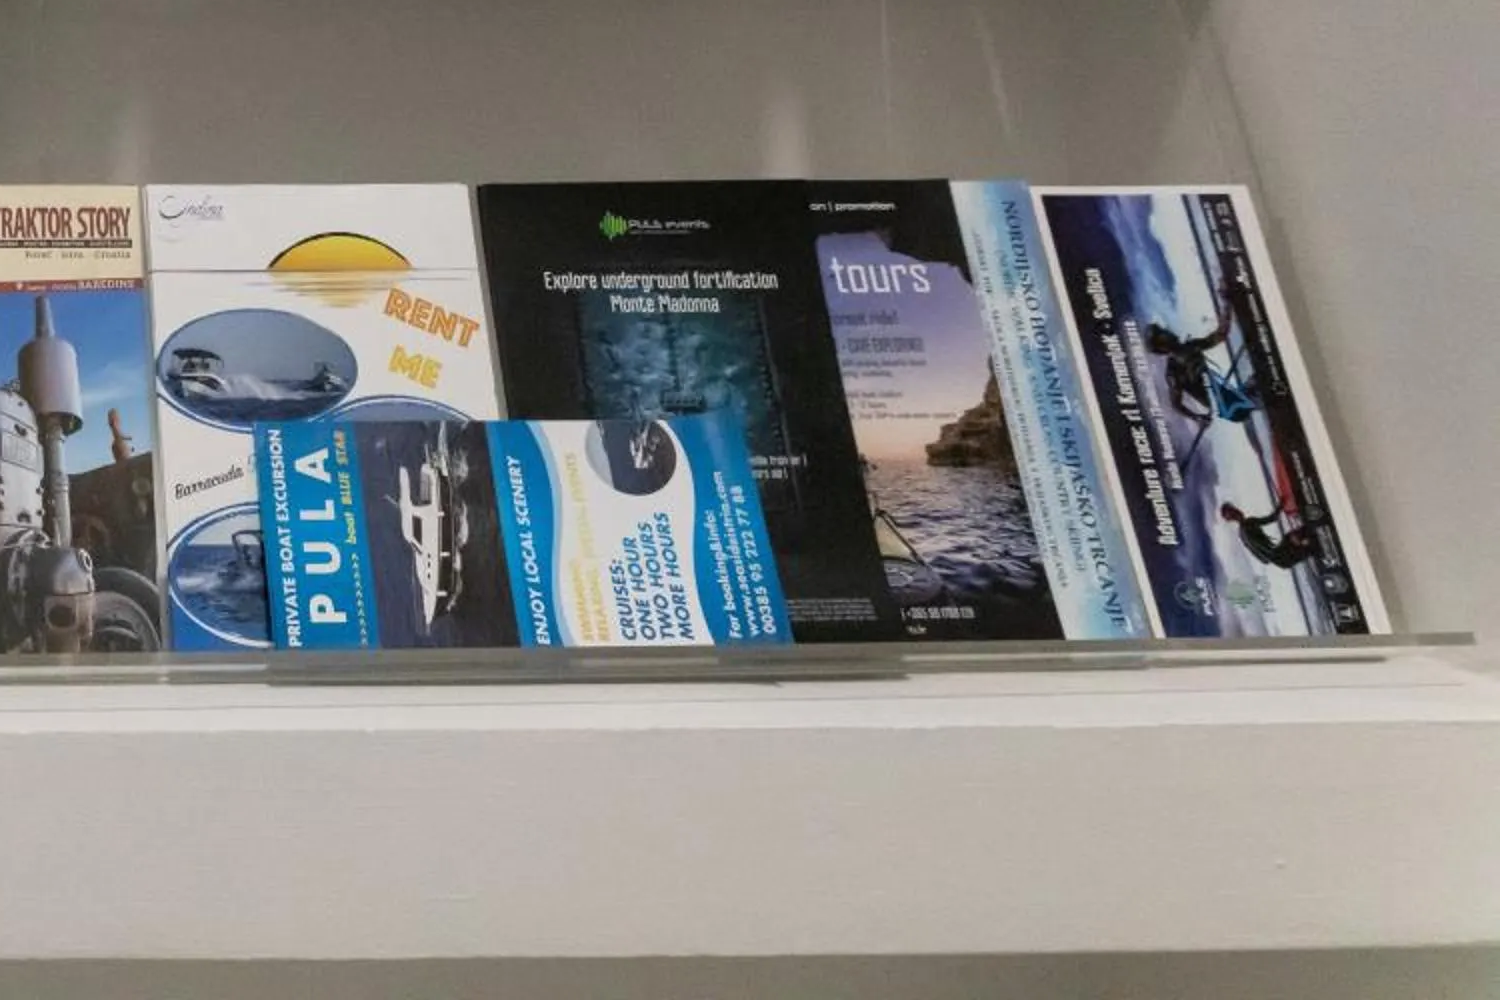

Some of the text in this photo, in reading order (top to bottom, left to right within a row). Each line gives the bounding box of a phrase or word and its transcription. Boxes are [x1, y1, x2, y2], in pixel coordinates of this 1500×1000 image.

[77, 207, 132, 238] STORY
[543, 270, 779, 293] Explore underground fortification
[829, 256, 932, 294] tours
[383, 286, 480, 348] RENT
[609, 295, 721, 313] Monte Madonna
[389, 344, 444, 388] ME
[1129, 425, 1157, 466] race:
[1142, 471, 1180, 546] Adventure
[267, 429, 303, 647] PRIVATE BOAT EXCURSION
[294, 447, 349, 624] PULA
[506, 455, 551, 645] ENJOY LOCAL SCENERY
[741, 531, 759, 558] 222
[621, 535, 658, 641] ONE HOUR
[637, 522, 676, 641] TWO HOURS
[653, 511, 695, 641] MORE HOURS
[749, 560, 765, 582] 95
[609, 559, 638, 642] CRUISES:
[755, 587, 777, 635] 00385
[728, 614, 744, 639] For
